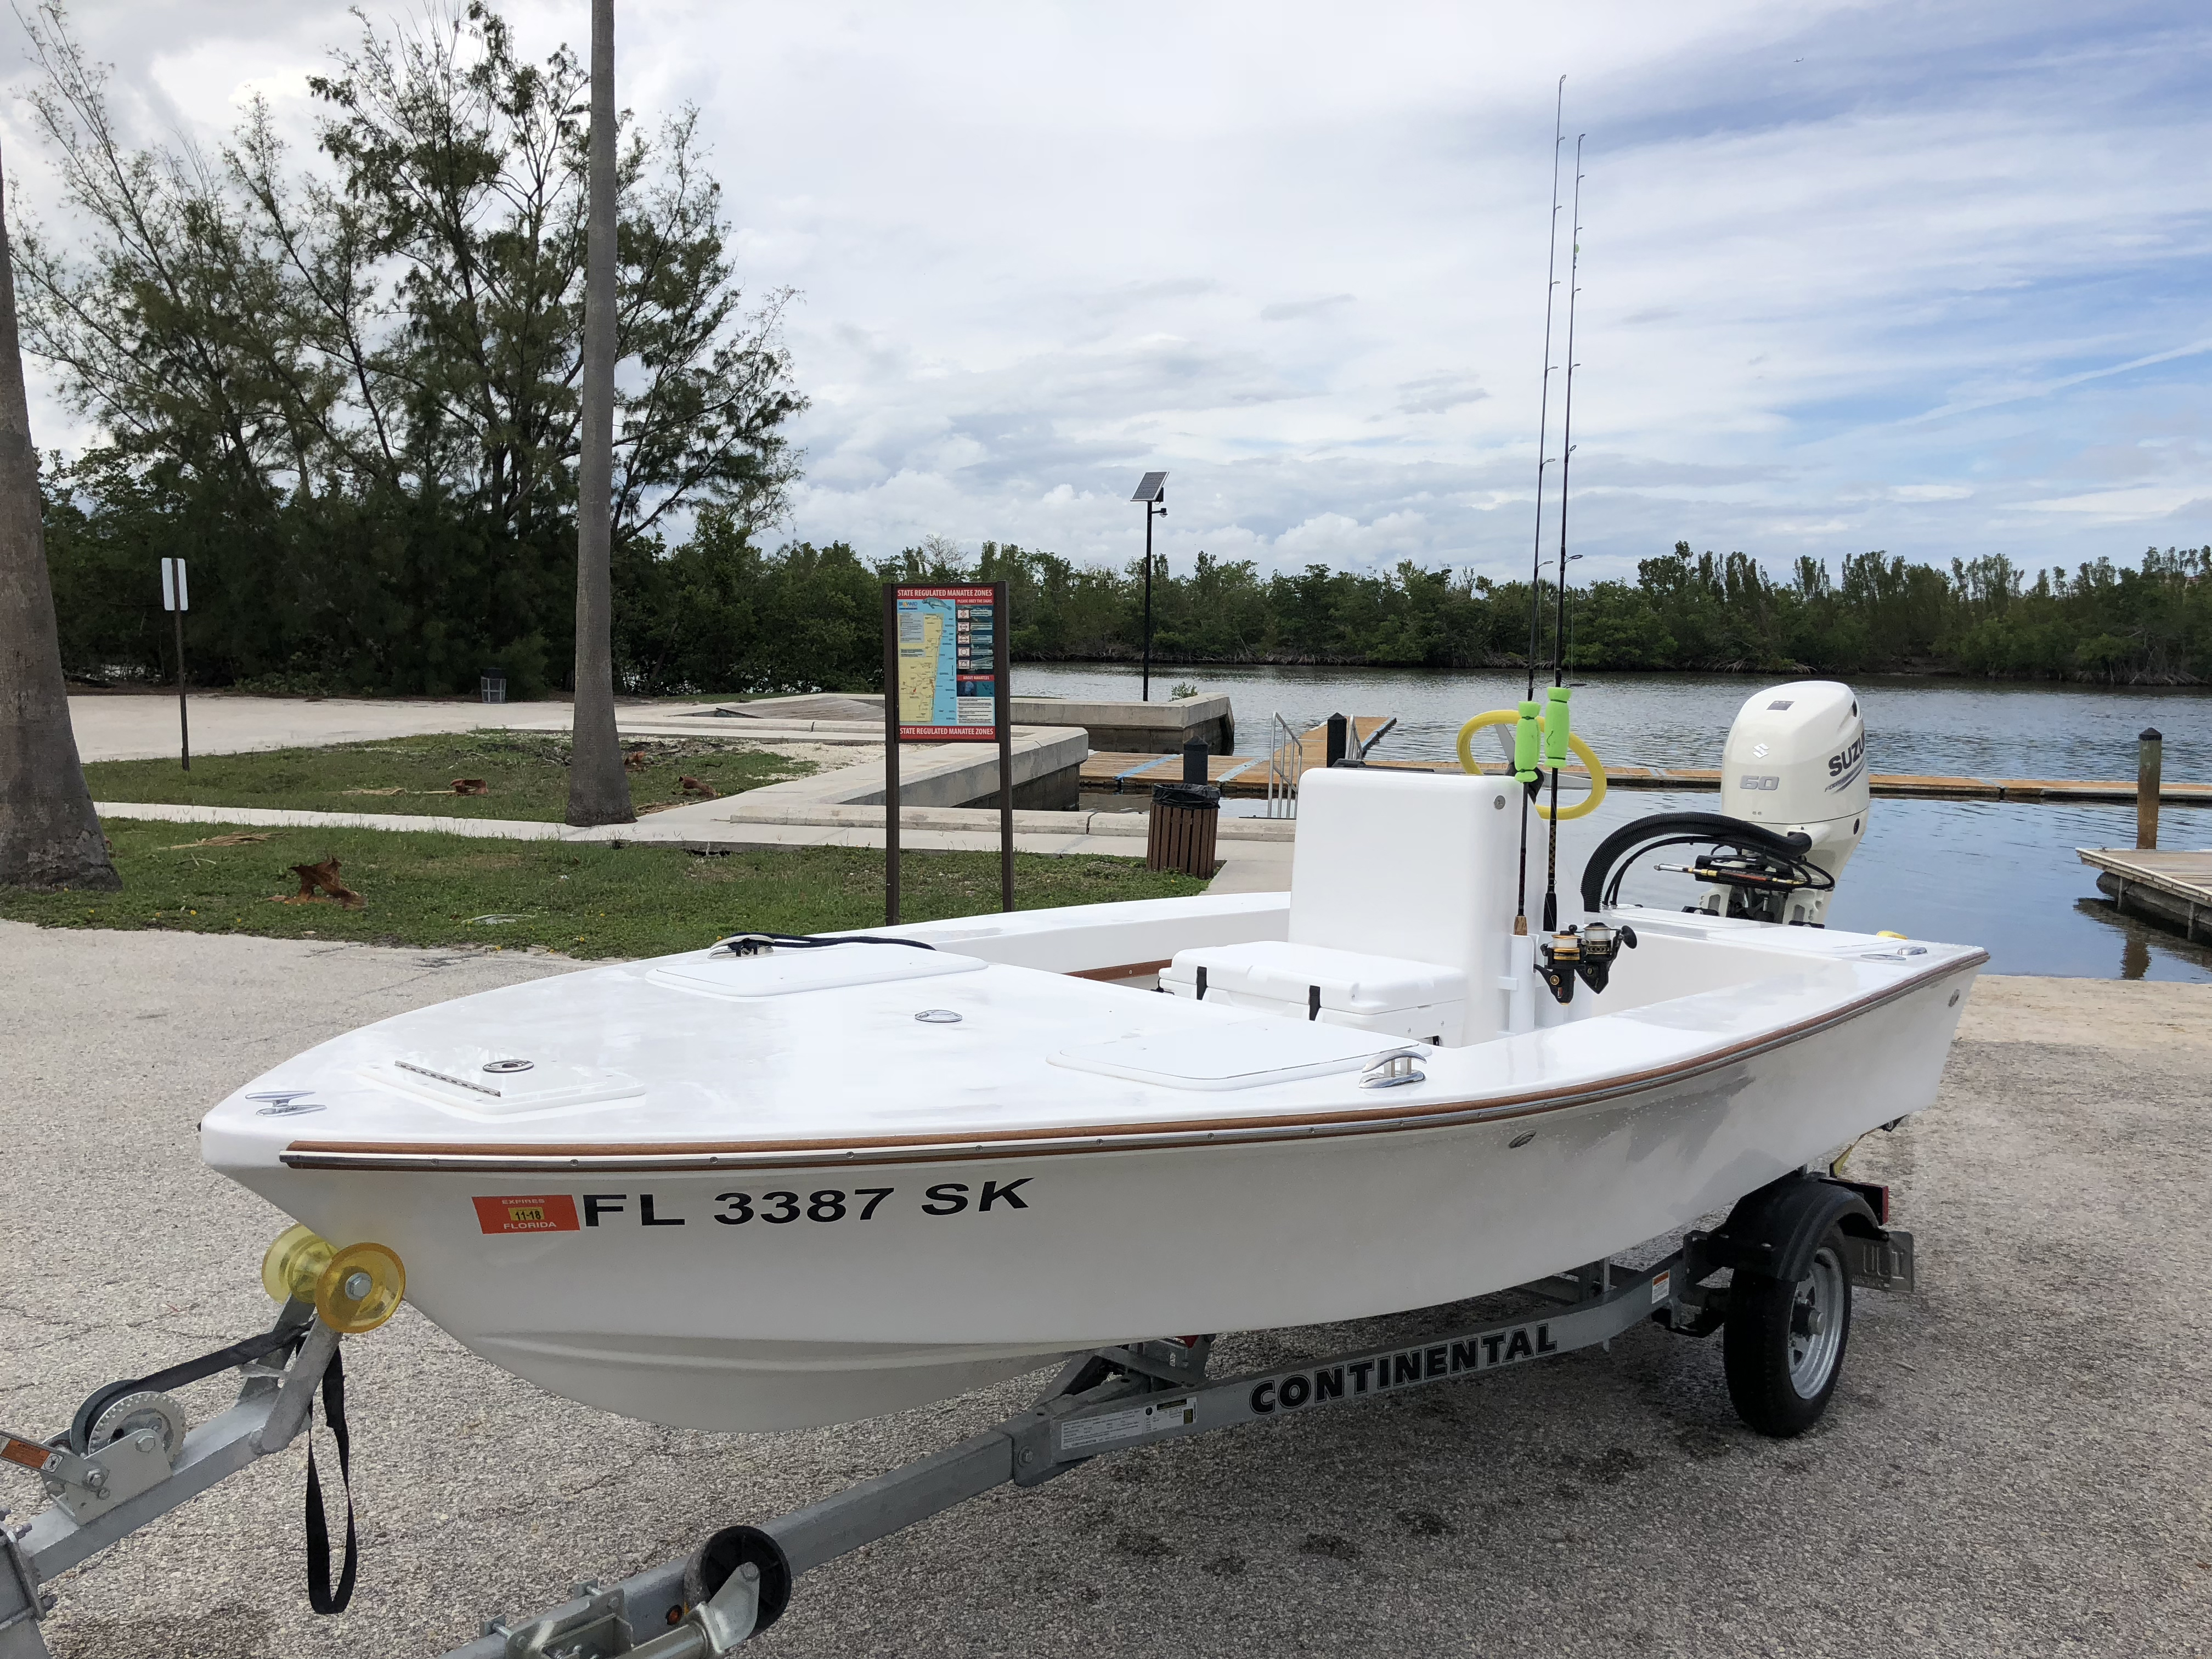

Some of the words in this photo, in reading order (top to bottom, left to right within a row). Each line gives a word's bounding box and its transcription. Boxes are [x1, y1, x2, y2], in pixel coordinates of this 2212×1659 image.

[1740, 775, 1780, 791] 60
[515, 1210, 541, 1221] 11-18
[583, 1194, 685, 1227] FL
[714, 1187, 894, 1224] 3387
[921, 1177, 1036, 1216] SK
[1249, 1323, 1557, 1415] CONTINENTAL
